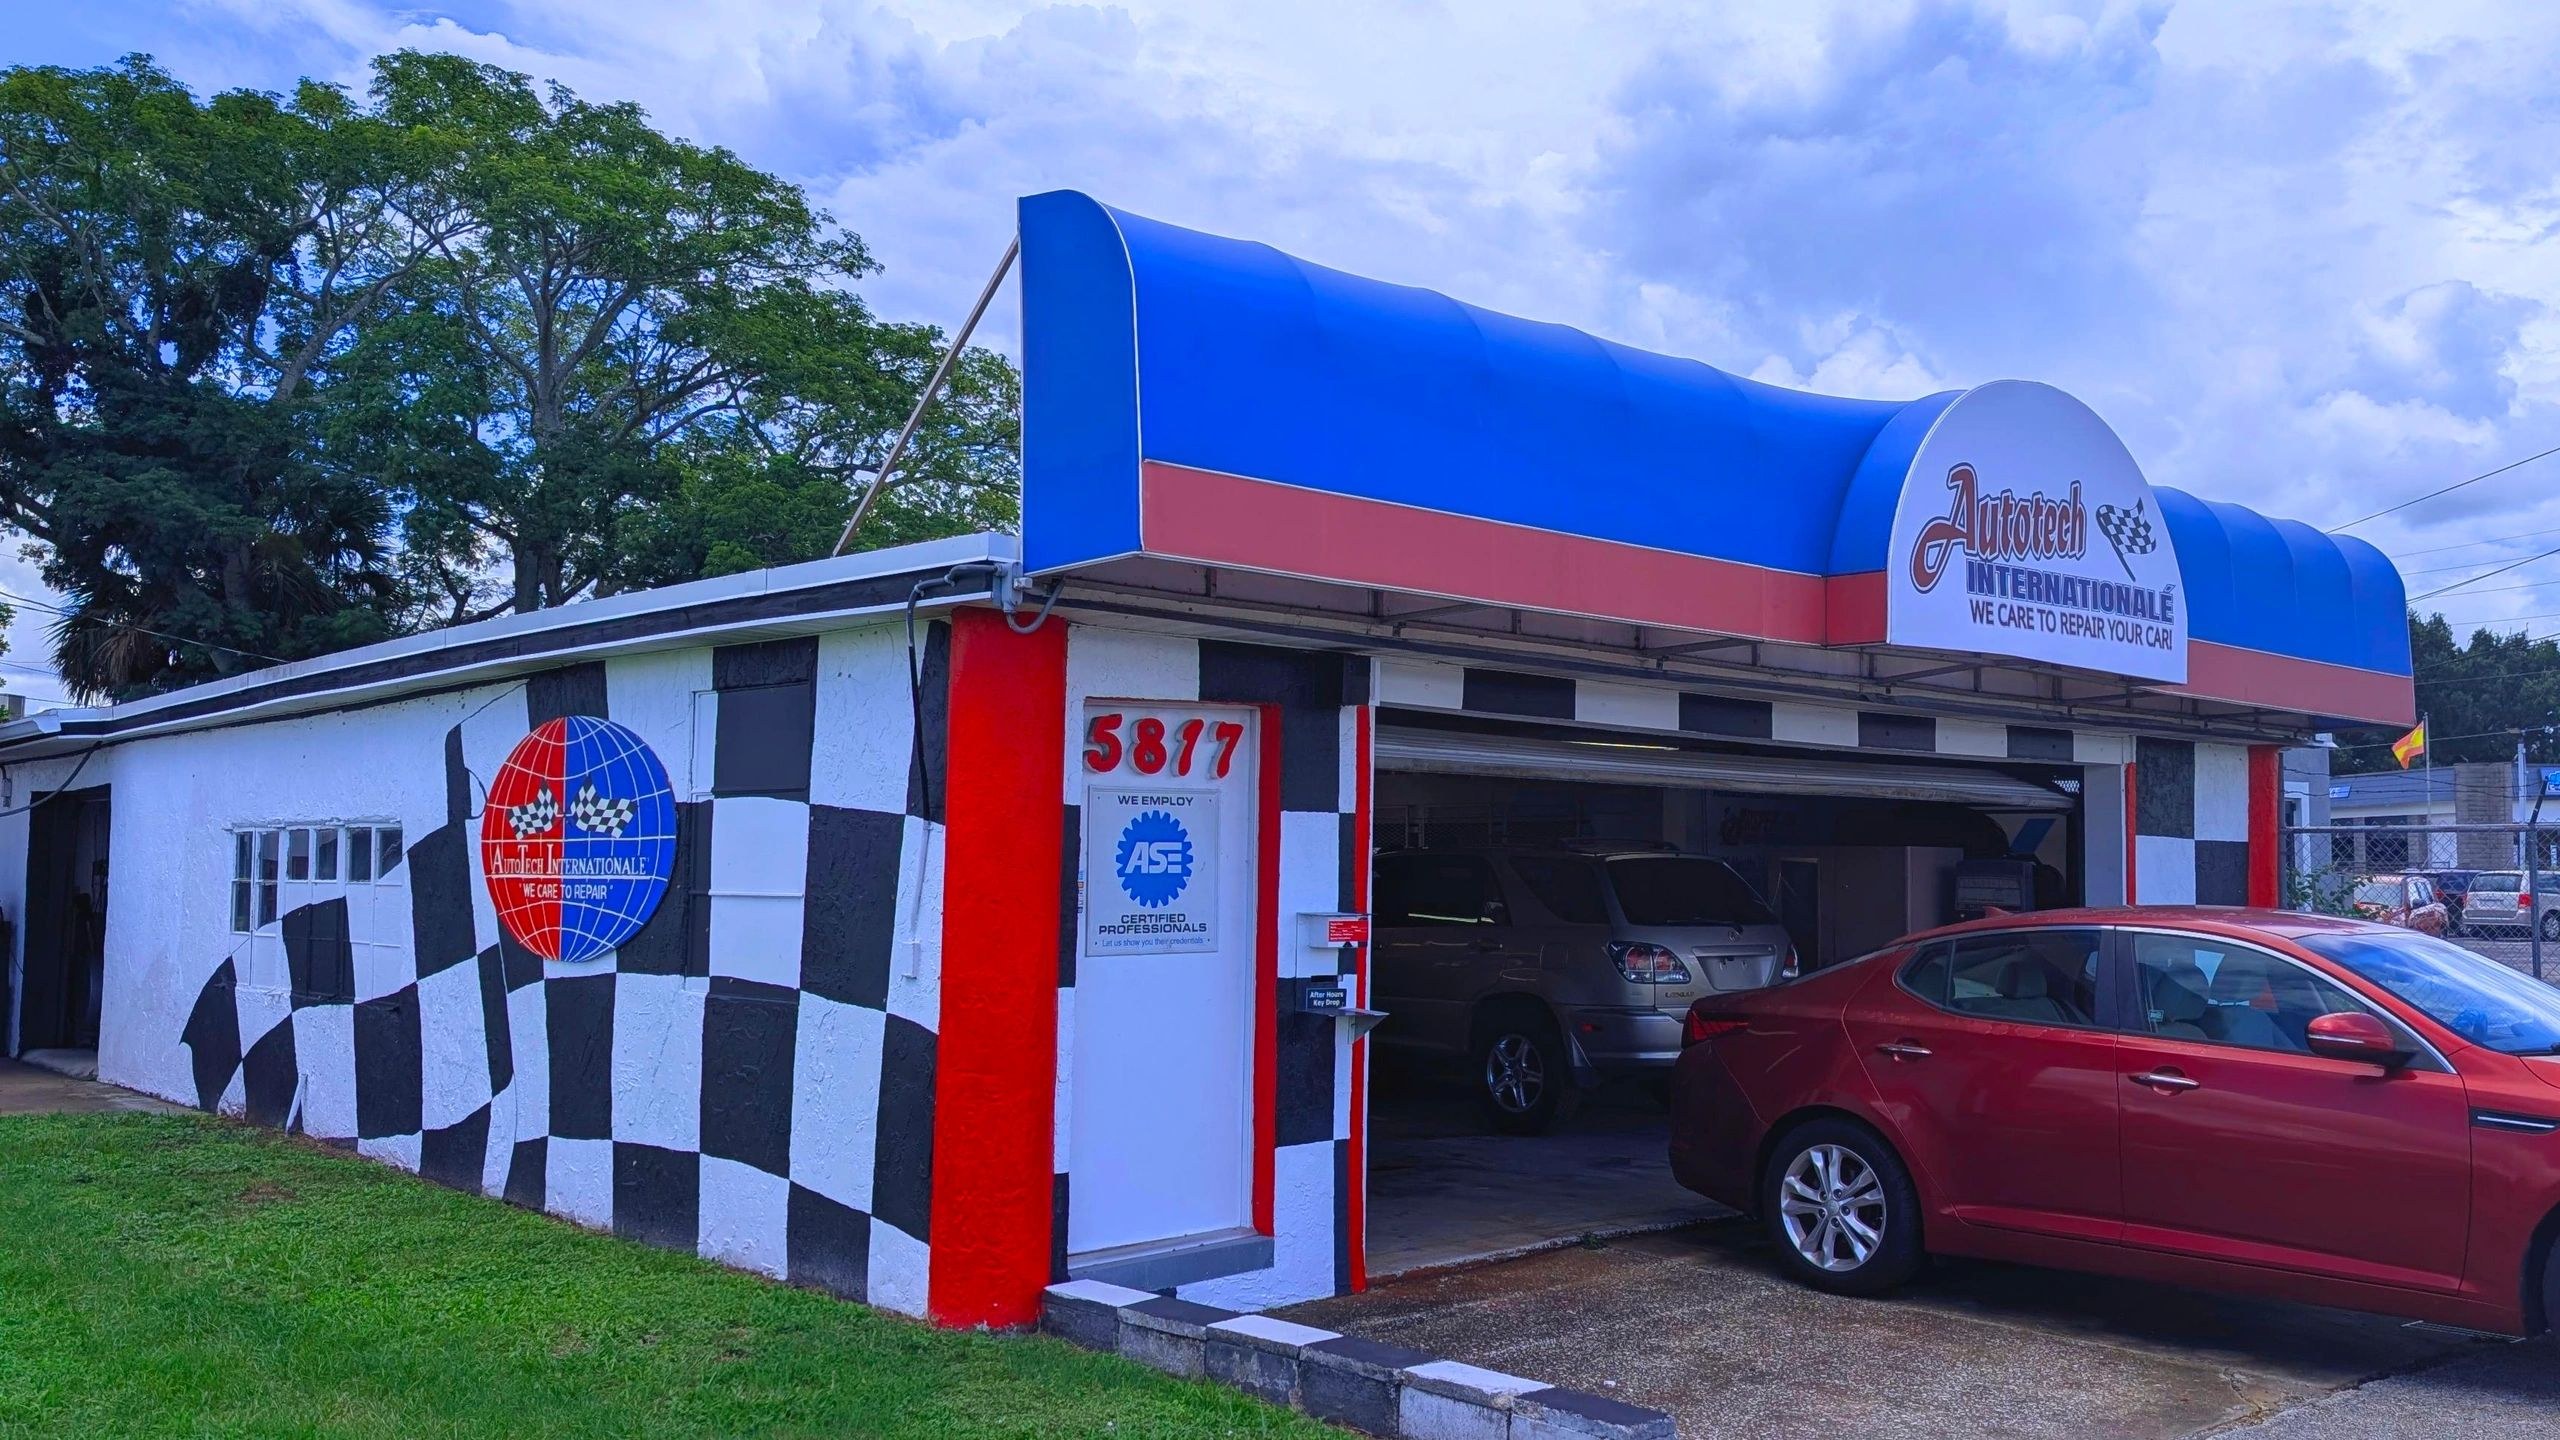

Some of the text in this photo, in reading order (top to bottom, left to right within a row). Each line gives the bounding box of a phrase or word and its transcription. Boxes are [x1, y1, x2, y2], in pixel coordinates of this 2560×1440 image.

[1910, 461, 2087, 594] Autotech
[1966, 560, 2176, 625] INTERNATIONALÉ
[1970, 599, 2172, 650] WE CARE TO REPAIR YOUR CAR!
[1084, 713, 1244, 780] 5817
[1118, 795, 1194, 807] WE EMPLOY
[1125, 841, 1182, 874] ASE
[537, 883, 558, 899] CARE
[560, 885, 572, 898] TO
[1120, 913, 1186, 924] CERTIFIED
[1098, 923, 1207, 935] PROFESSIONALS
[1123, 939, 1140, 947] show
[1141, 939, 1154, 948] you
[1313, 999, 1325, 1007] Key
